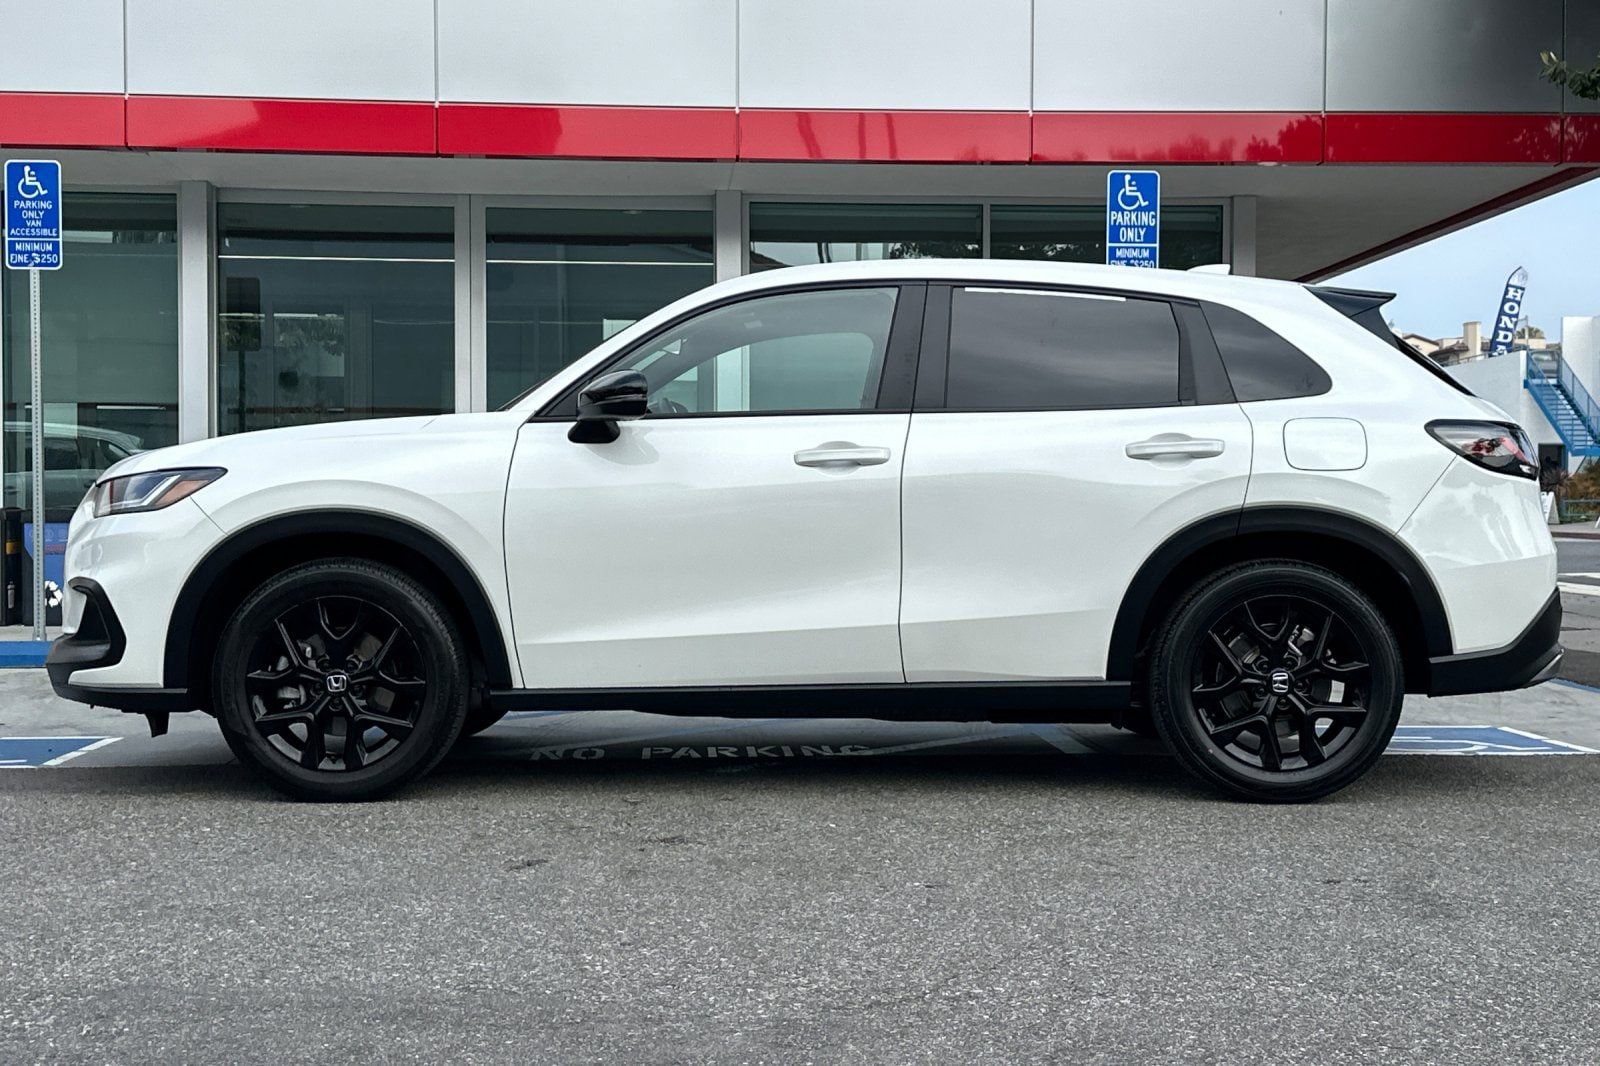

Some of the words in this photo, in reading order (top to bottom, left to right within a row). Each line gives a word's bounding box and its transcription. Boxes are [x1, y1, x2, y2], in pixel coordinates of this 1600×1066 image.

[14, 200, 53, 209] PARKING
[22, 210, 44, 219] ONLY
[1110, 211, 1156, 226] PARKING
[10, 228, 58, 236] ACCESSIBLE
[1119, 227, 1147, 242] ONLY
[15, 242, 53, 252] MINIMUM
[1115, 248, 1150, 258] MINIMUM
[1492, 286, 1524, 356] HONDA
[528, 747, 605, 760] NO
[641, 745, 870, 760] PARKING
